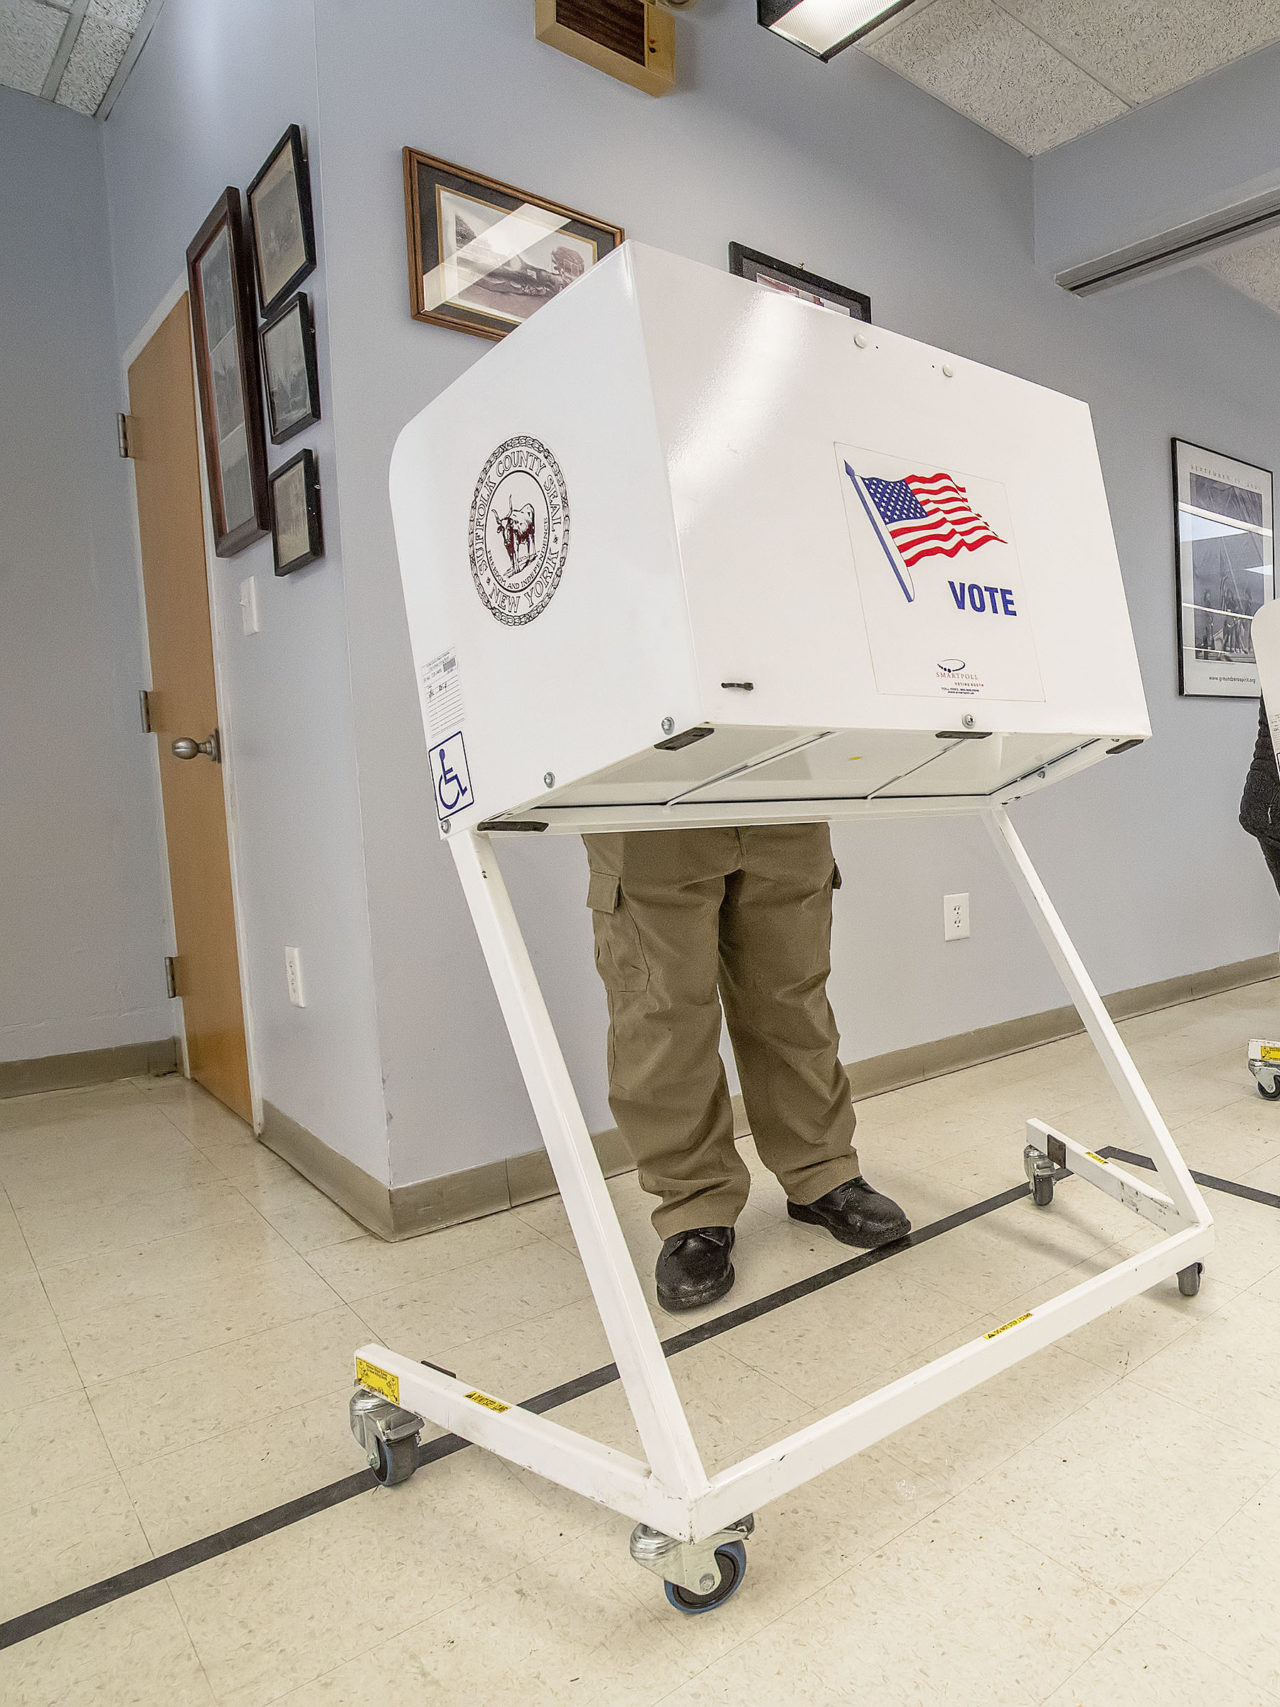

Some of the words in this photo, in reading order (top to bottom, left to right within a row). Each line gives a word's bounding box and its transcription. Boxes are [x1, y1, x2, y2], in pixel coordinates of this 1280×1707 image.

[475, 475, 497, 576] SUFFOLK
[495, 450, 546, 476] COUNTY
[543, 475, 562, 532] SEAL
[489, 583, 521, 613] NEW
[524, 550, 560, 609] YORK
[507, 582, 520, 590] AND
[947, 581, 1018, 617] VOTE
